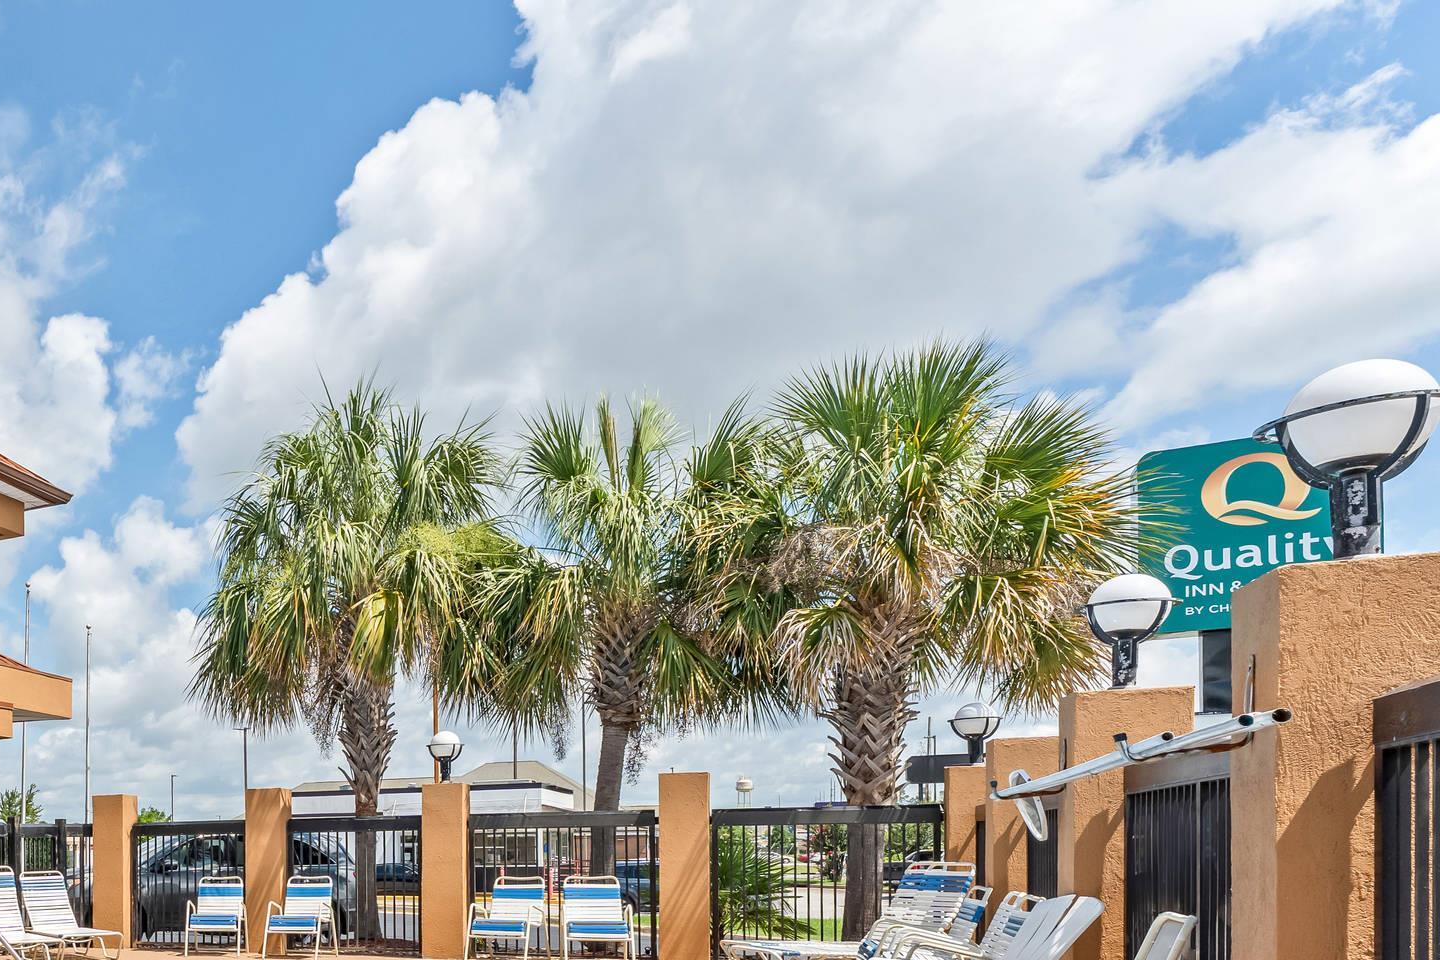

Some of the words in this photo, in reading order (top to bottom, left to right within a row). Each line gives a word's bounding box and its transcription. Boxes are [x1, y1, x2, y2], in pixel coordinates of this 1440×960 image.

[1185, 582, 1224, 598] INN
[1185, 606, 1205, 616] BY
[1208, 603, 1233, 614] CH
